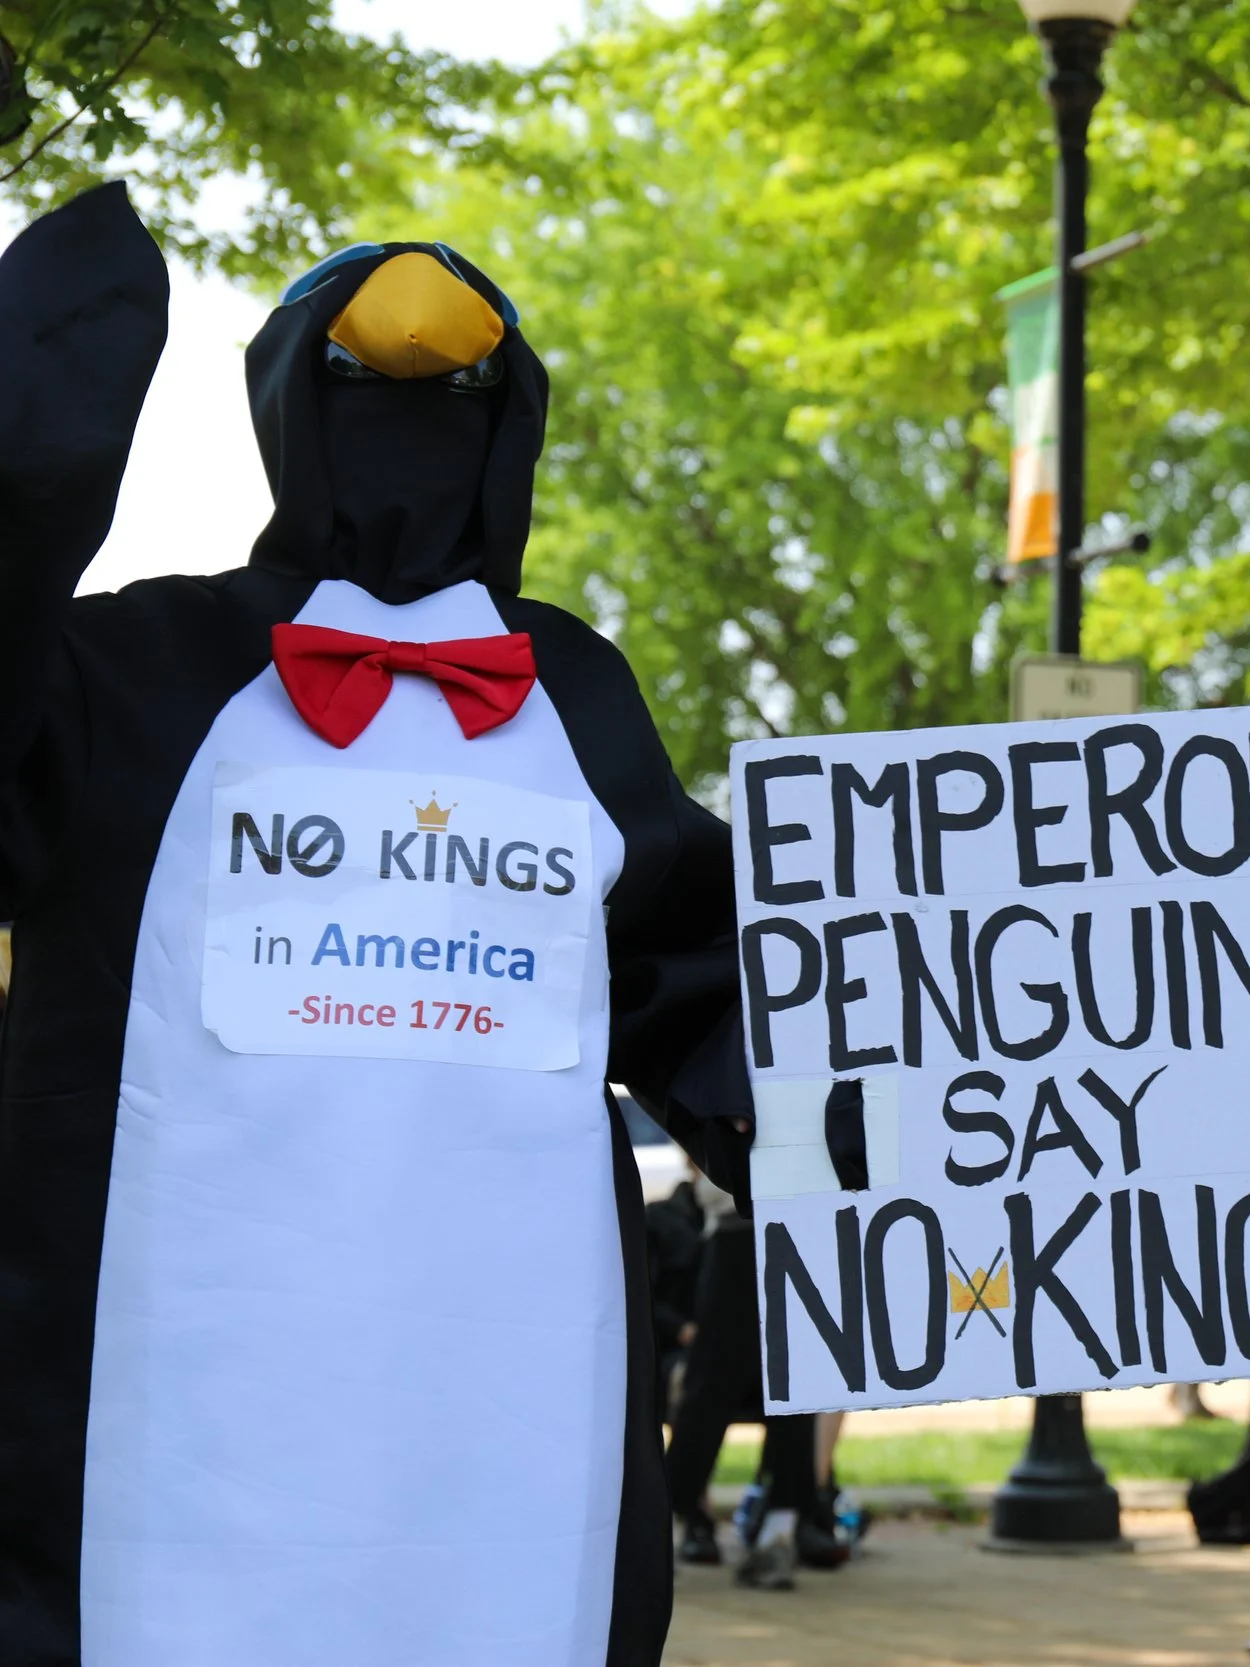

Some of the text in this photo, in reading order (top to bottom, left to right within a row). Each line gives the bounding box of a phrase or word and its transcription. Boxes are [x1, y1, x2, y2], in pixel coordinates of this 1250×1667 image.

[379, 829, 576, 896] KINGS
[253, 923, 535, 982] in America
[288, 994, 505, 1035] -Since 1776-
[942, 1065, 1169, 1187] SAY
[763, 1198, 947, 1402] NO
